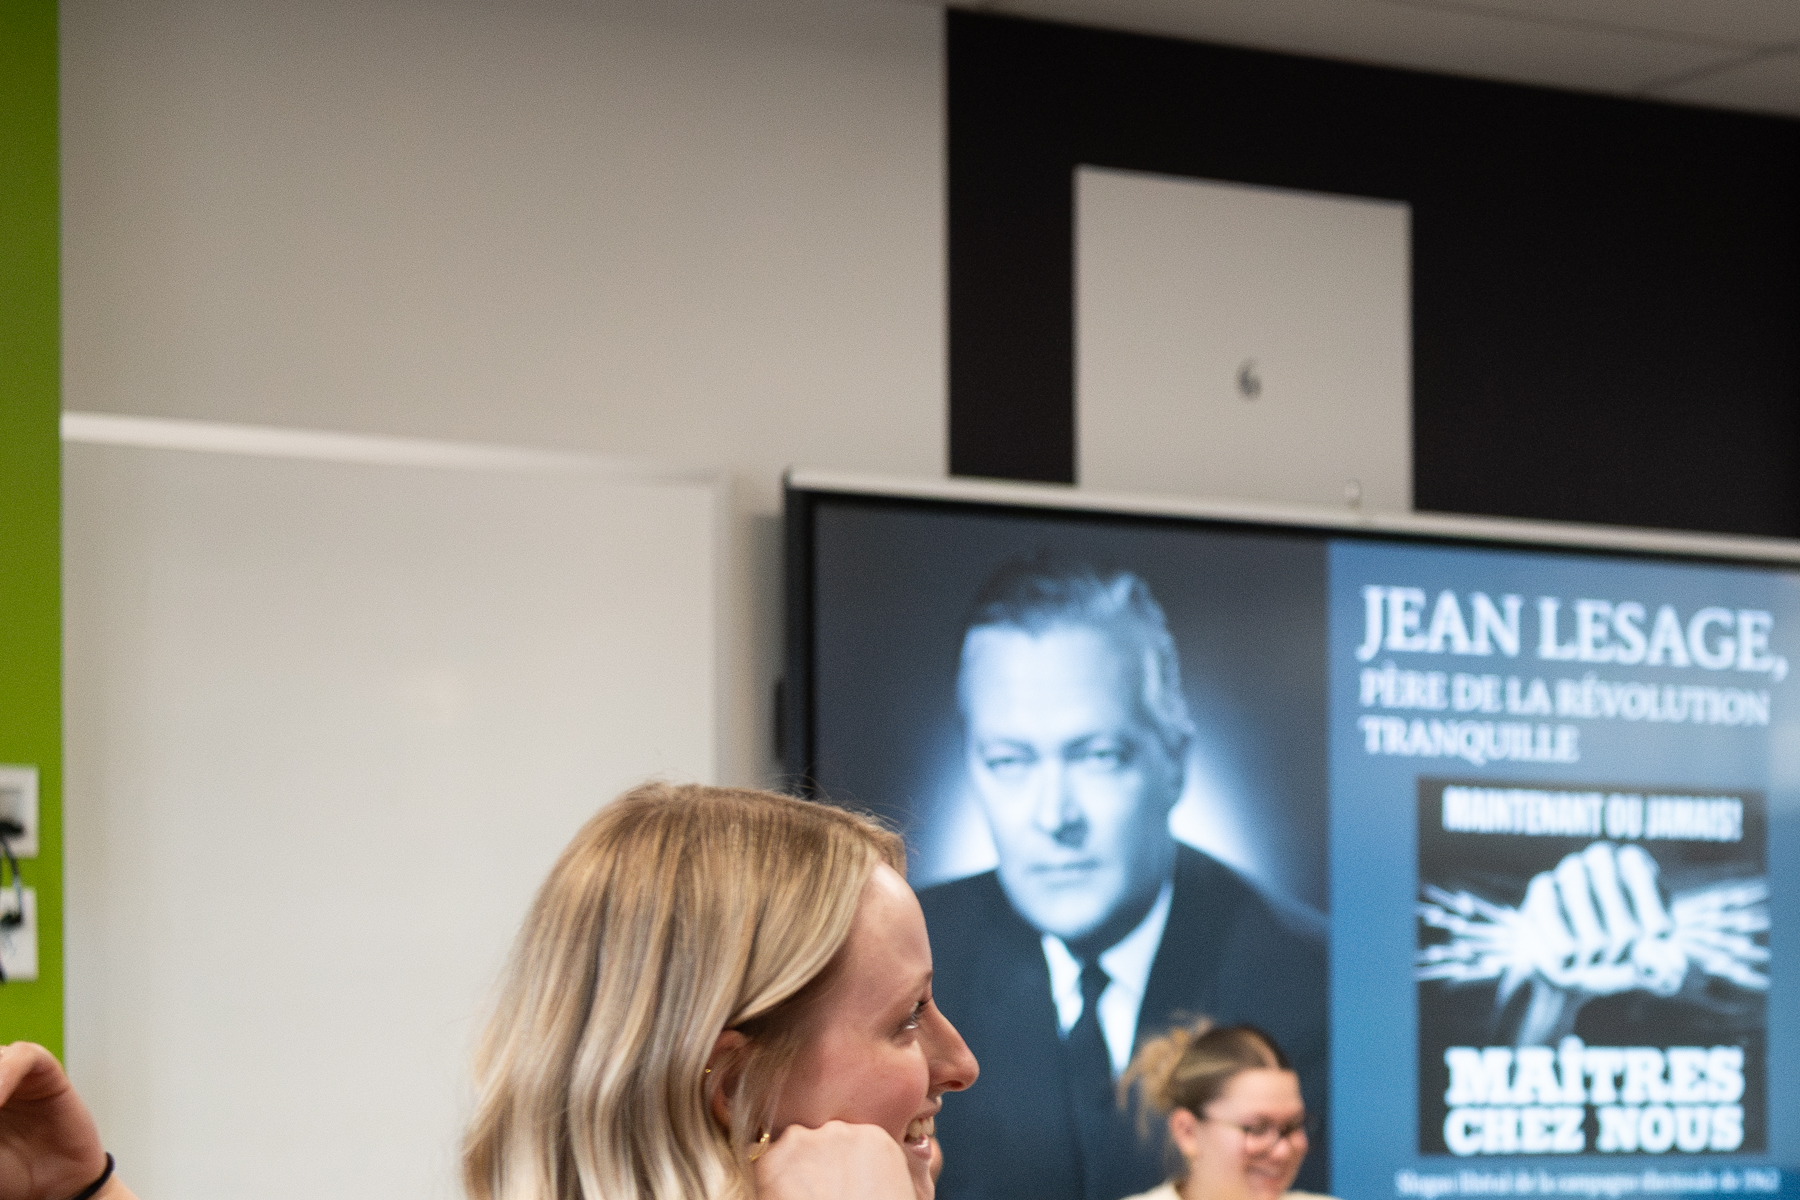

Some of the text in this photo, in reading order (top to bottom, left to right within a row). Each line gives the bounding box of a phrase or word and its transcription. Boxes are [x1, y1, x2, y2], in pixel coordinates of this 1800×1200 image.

[1357, 584, 1787, 681] JEAN LESAGE,
[1360, 661, 1771, 726] PÈRE DE LA RÉVOLUTION
[1360, 715, 1577, 765] TRANQUILLE
[1442, 785, 1604, 837] MAINTENANT
[1605, 792, 1644, 838] OU
[1444, 1034, 1746, 1106] MAÎTRES
[1443, 1104, 1746, 1158] CHEZ NOUS
